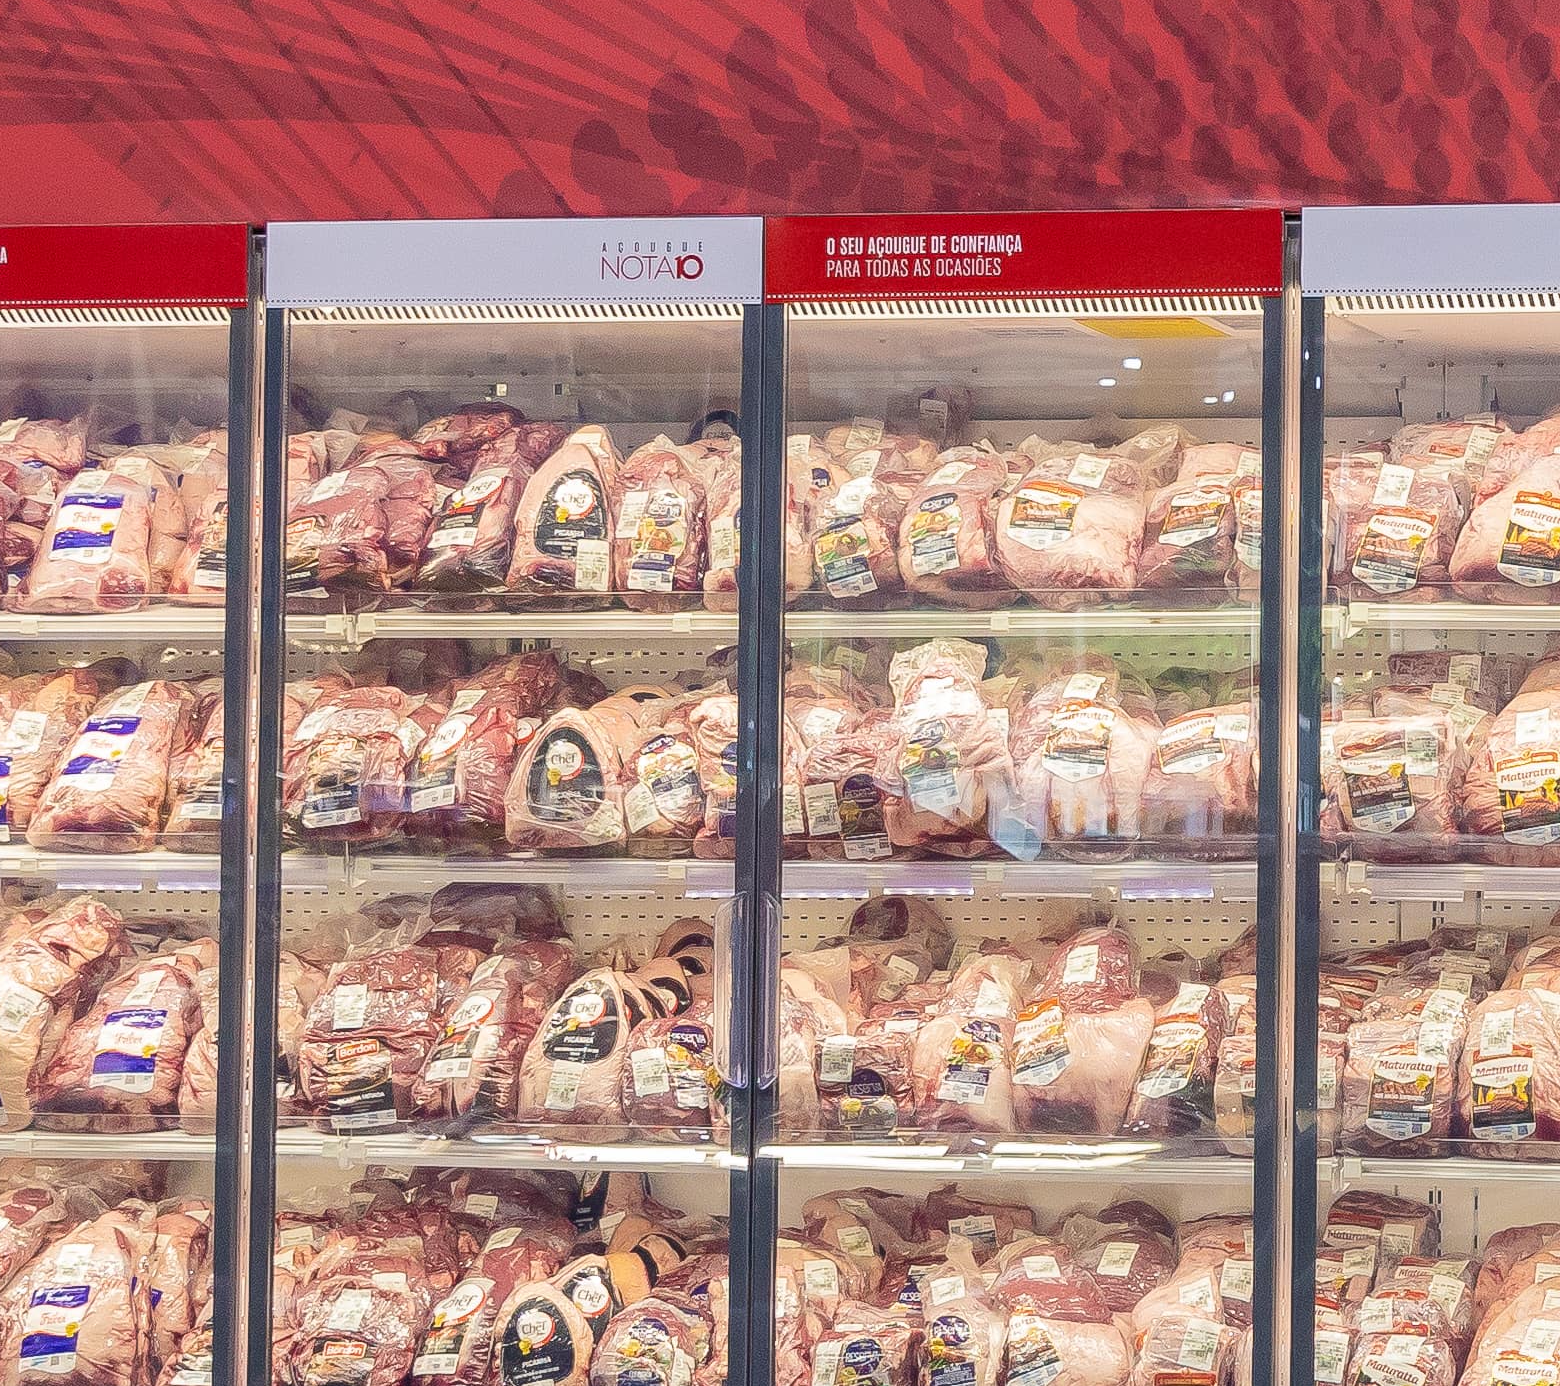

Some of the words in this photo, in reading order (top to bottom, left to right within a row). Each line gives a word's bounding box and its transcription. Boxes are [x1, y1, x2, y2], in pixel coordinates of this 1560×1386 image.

[602, 242, 702, 254] AÇOUGUE
[827, 238, 834, 255] O
[840, 237, 863, 255] SEU
[868, 236, 926, 257] AÇOUGUE
[931, 236, 946, 253] DE
[951, 234, 1022, 257] CONFIANÇA
[601, 254, 703, 281] NOTA10
[827, 260, 860, 277] PARA
[865, 259, 909, 277] TODAS
[914, 259, 930, 276] AS
[936, 255, 1001, 276] OCASIÕES
[1375, 517, 1426, 534] Maturatta
[551, 752, 575, 764] Chef
[1500, 768, 1556, 783] Maturatta
[575, 1003, 598, 1013] Chef
[339, 1041, 376, 1057] Bordon
[1380, 1060, 1432, 1072] Maturatta
[1476, 1064, 1529, 1075] Maturatta
[577, 1288, 602, 1302] Chef
[522, 1321, 546, 1333] Chef
[325, 1344, 365, 1356] Bordon
[1366, 1359, 1419, 1385] Maturatta
[1497, 1364, 1553, 1378] Maturatta
